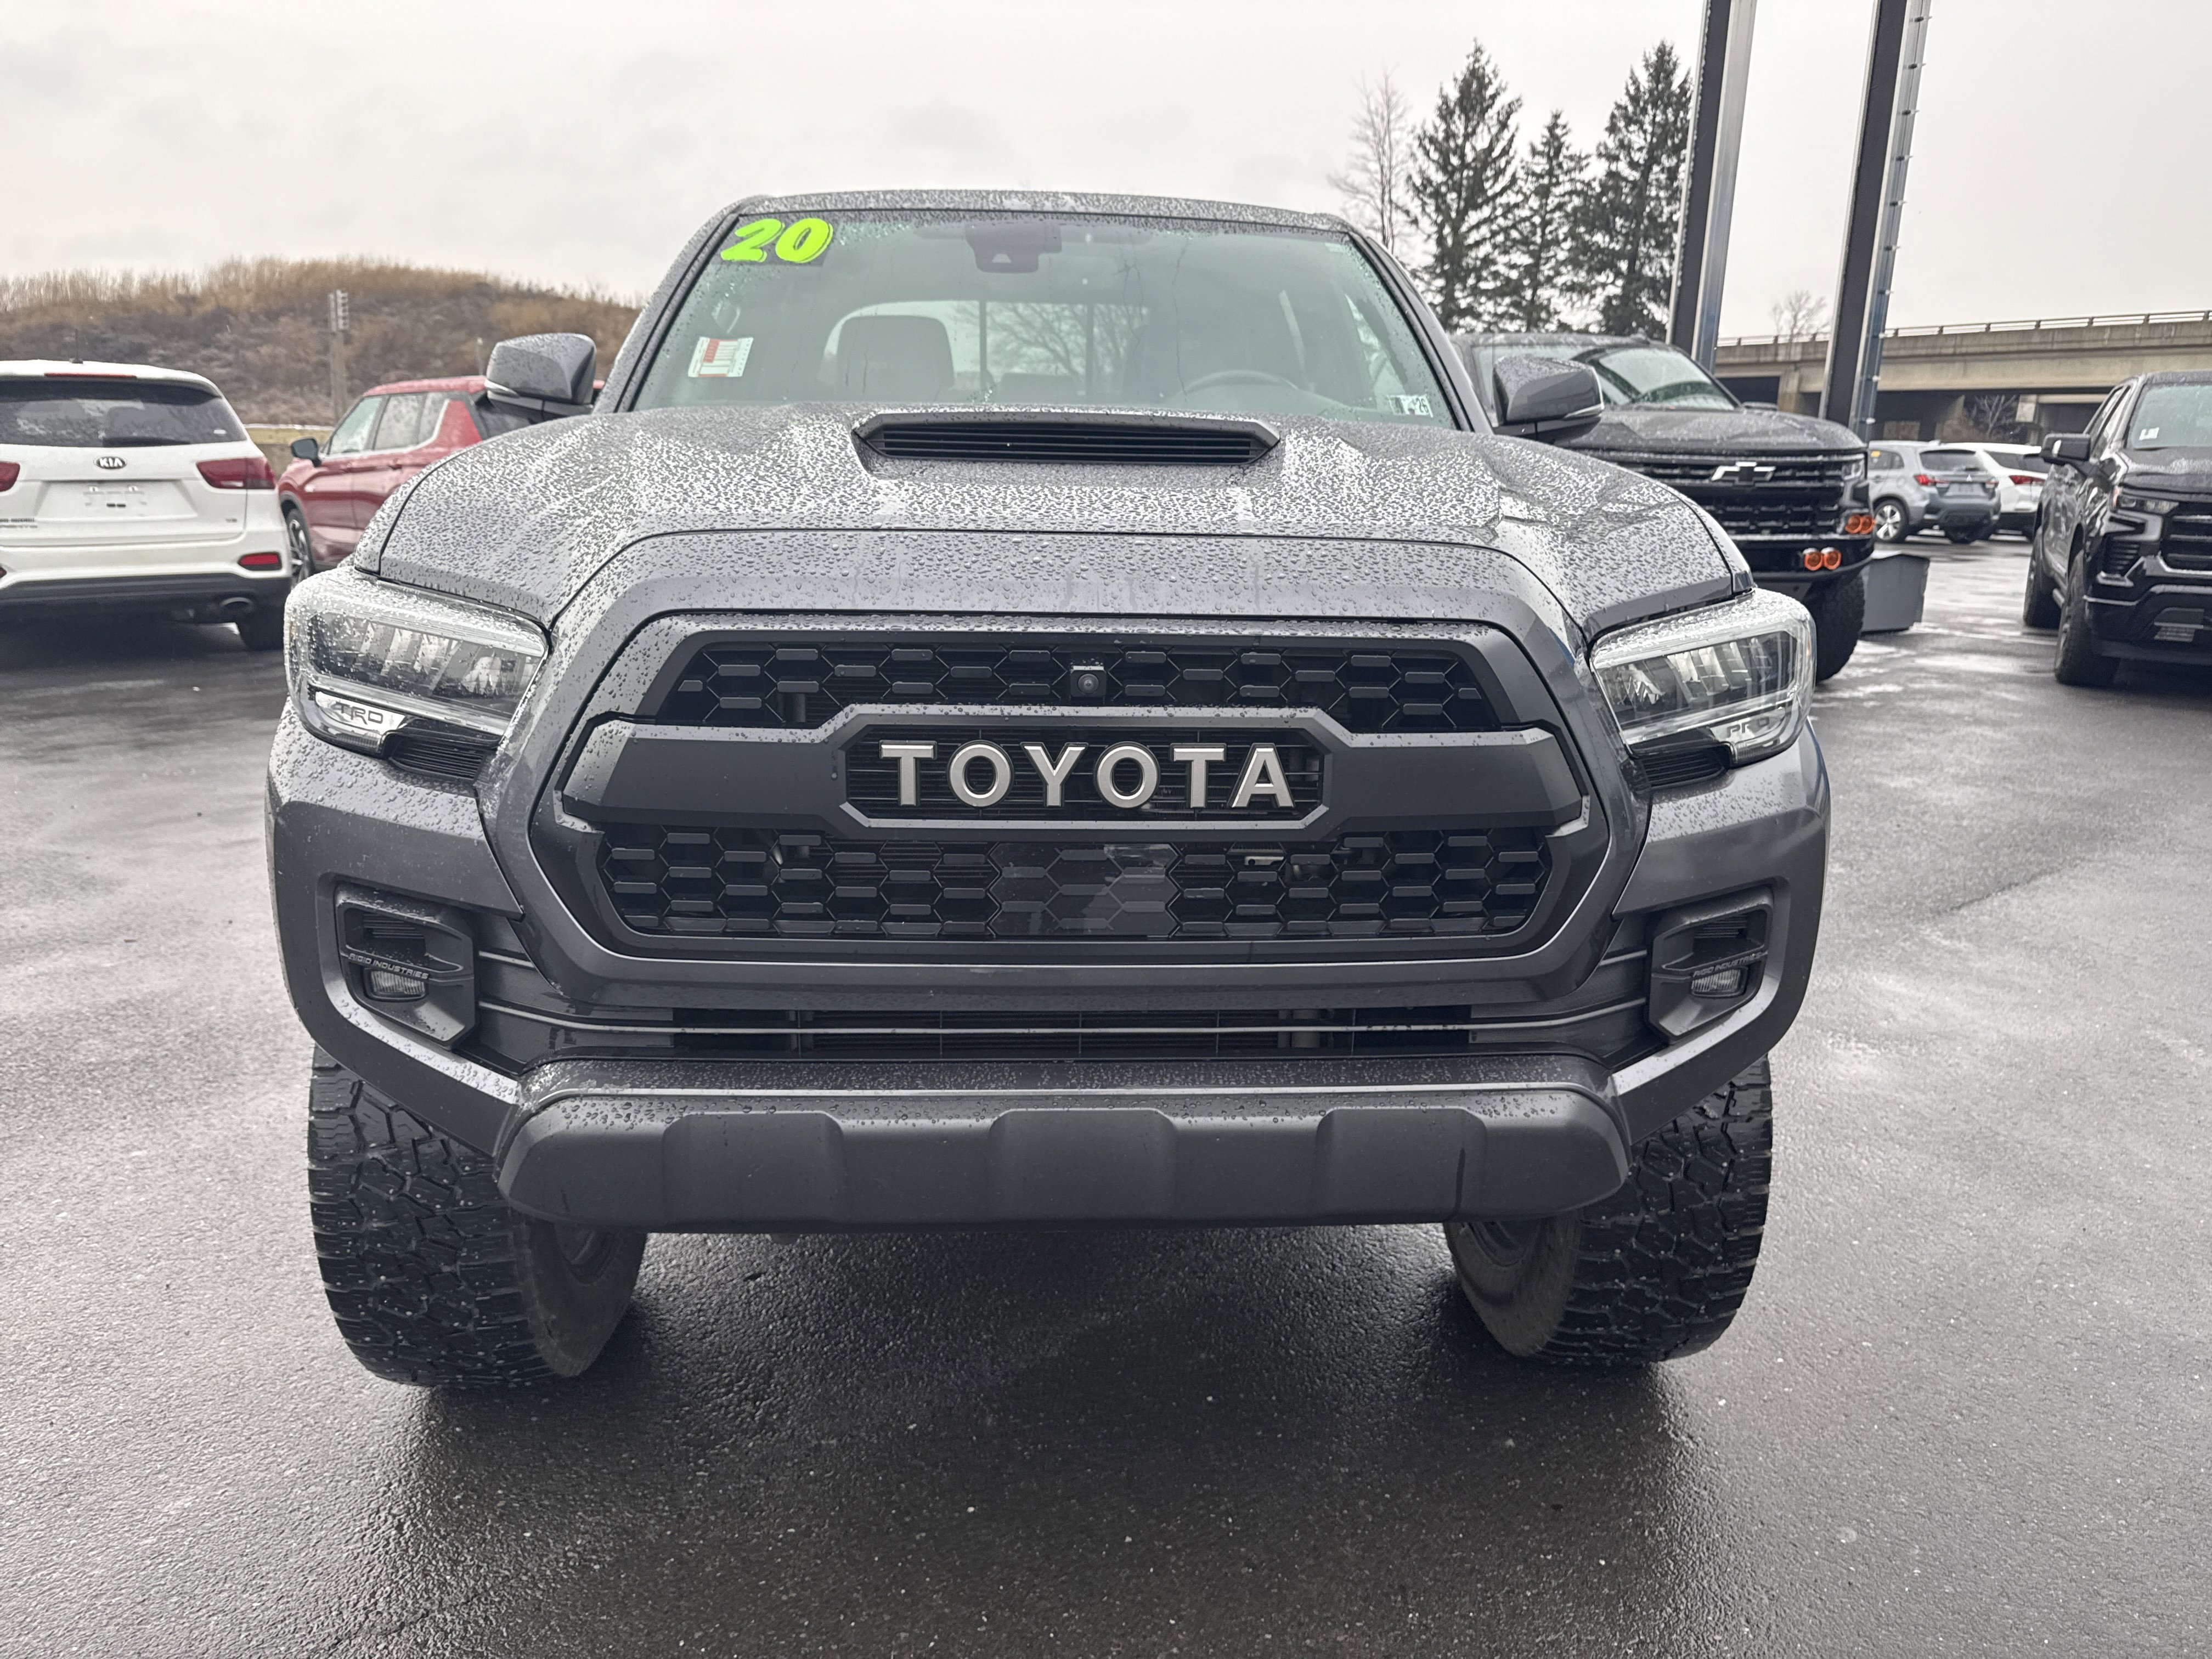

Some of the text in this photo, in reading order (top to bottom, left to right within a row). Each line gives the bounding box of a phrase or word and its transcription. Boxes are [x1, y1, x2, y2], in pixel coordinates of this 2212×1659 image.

[720, 217, 833, 263] 20
[99, 457, 123, 467] KIA
[333, 701, 384, 725] TRD
[879, 740, 1296, 809] TOYOTA
[348, 952, 429, 980] RIGID INDUSTRIES
